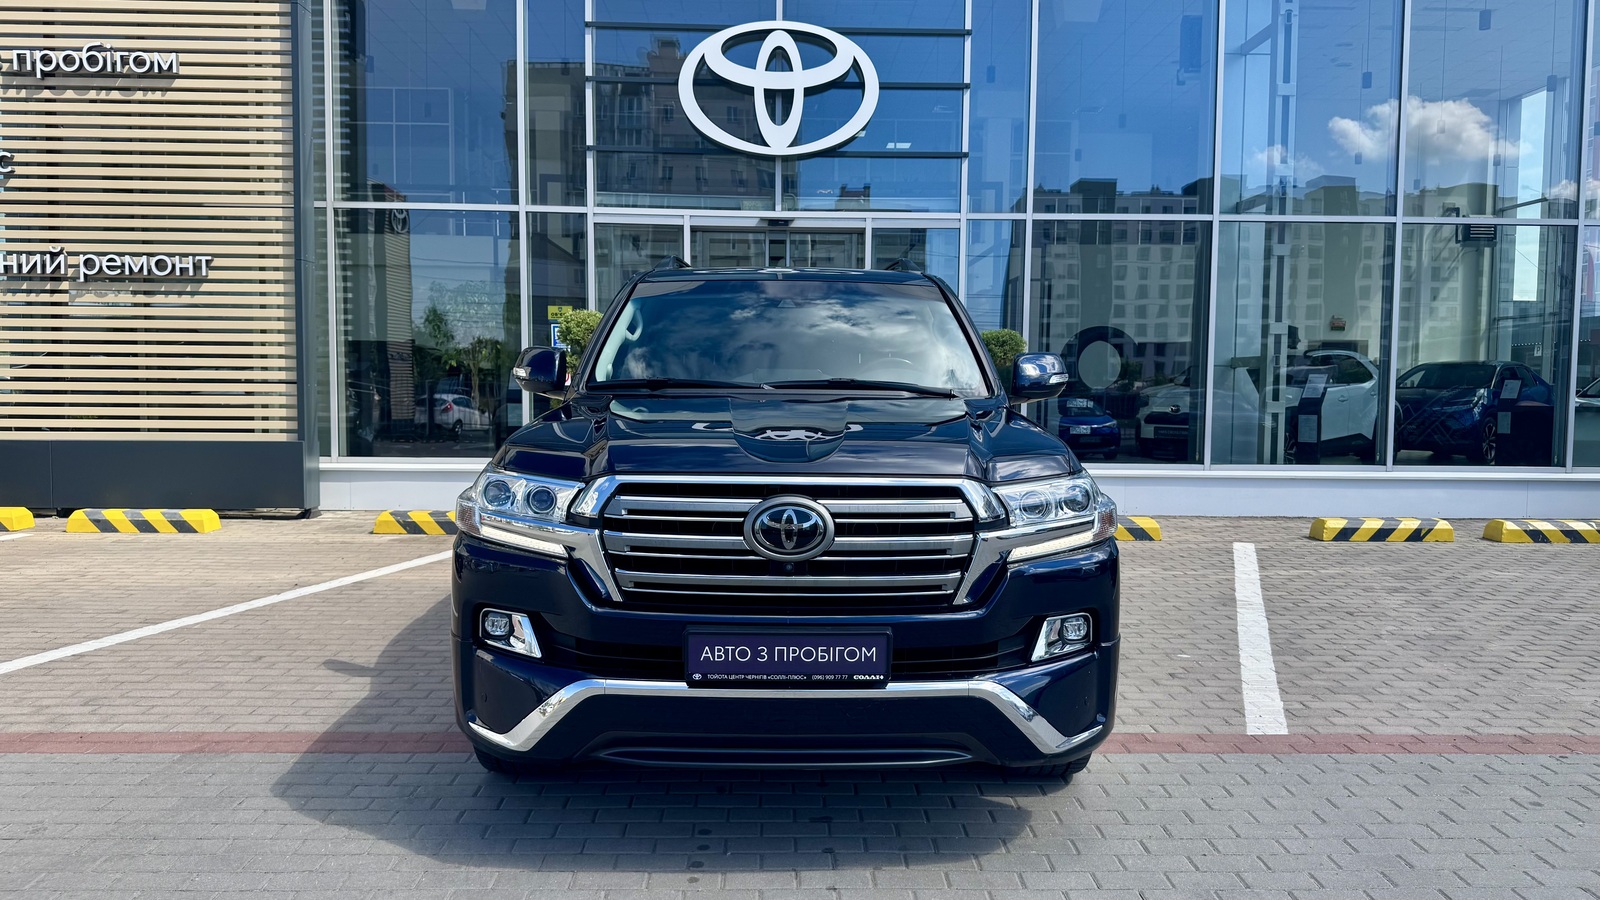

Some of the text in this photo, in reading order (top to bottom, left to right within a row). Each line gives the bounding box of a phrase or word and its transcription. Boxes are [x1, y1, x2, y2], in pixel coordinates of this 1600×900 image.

[12, 41, 179, 79] пробігом
[79, 253, 213, 283] ремонт
[700, 646, 751, 661] АВТО
[774, 646, 876, 662] ПРОБІГОМ
